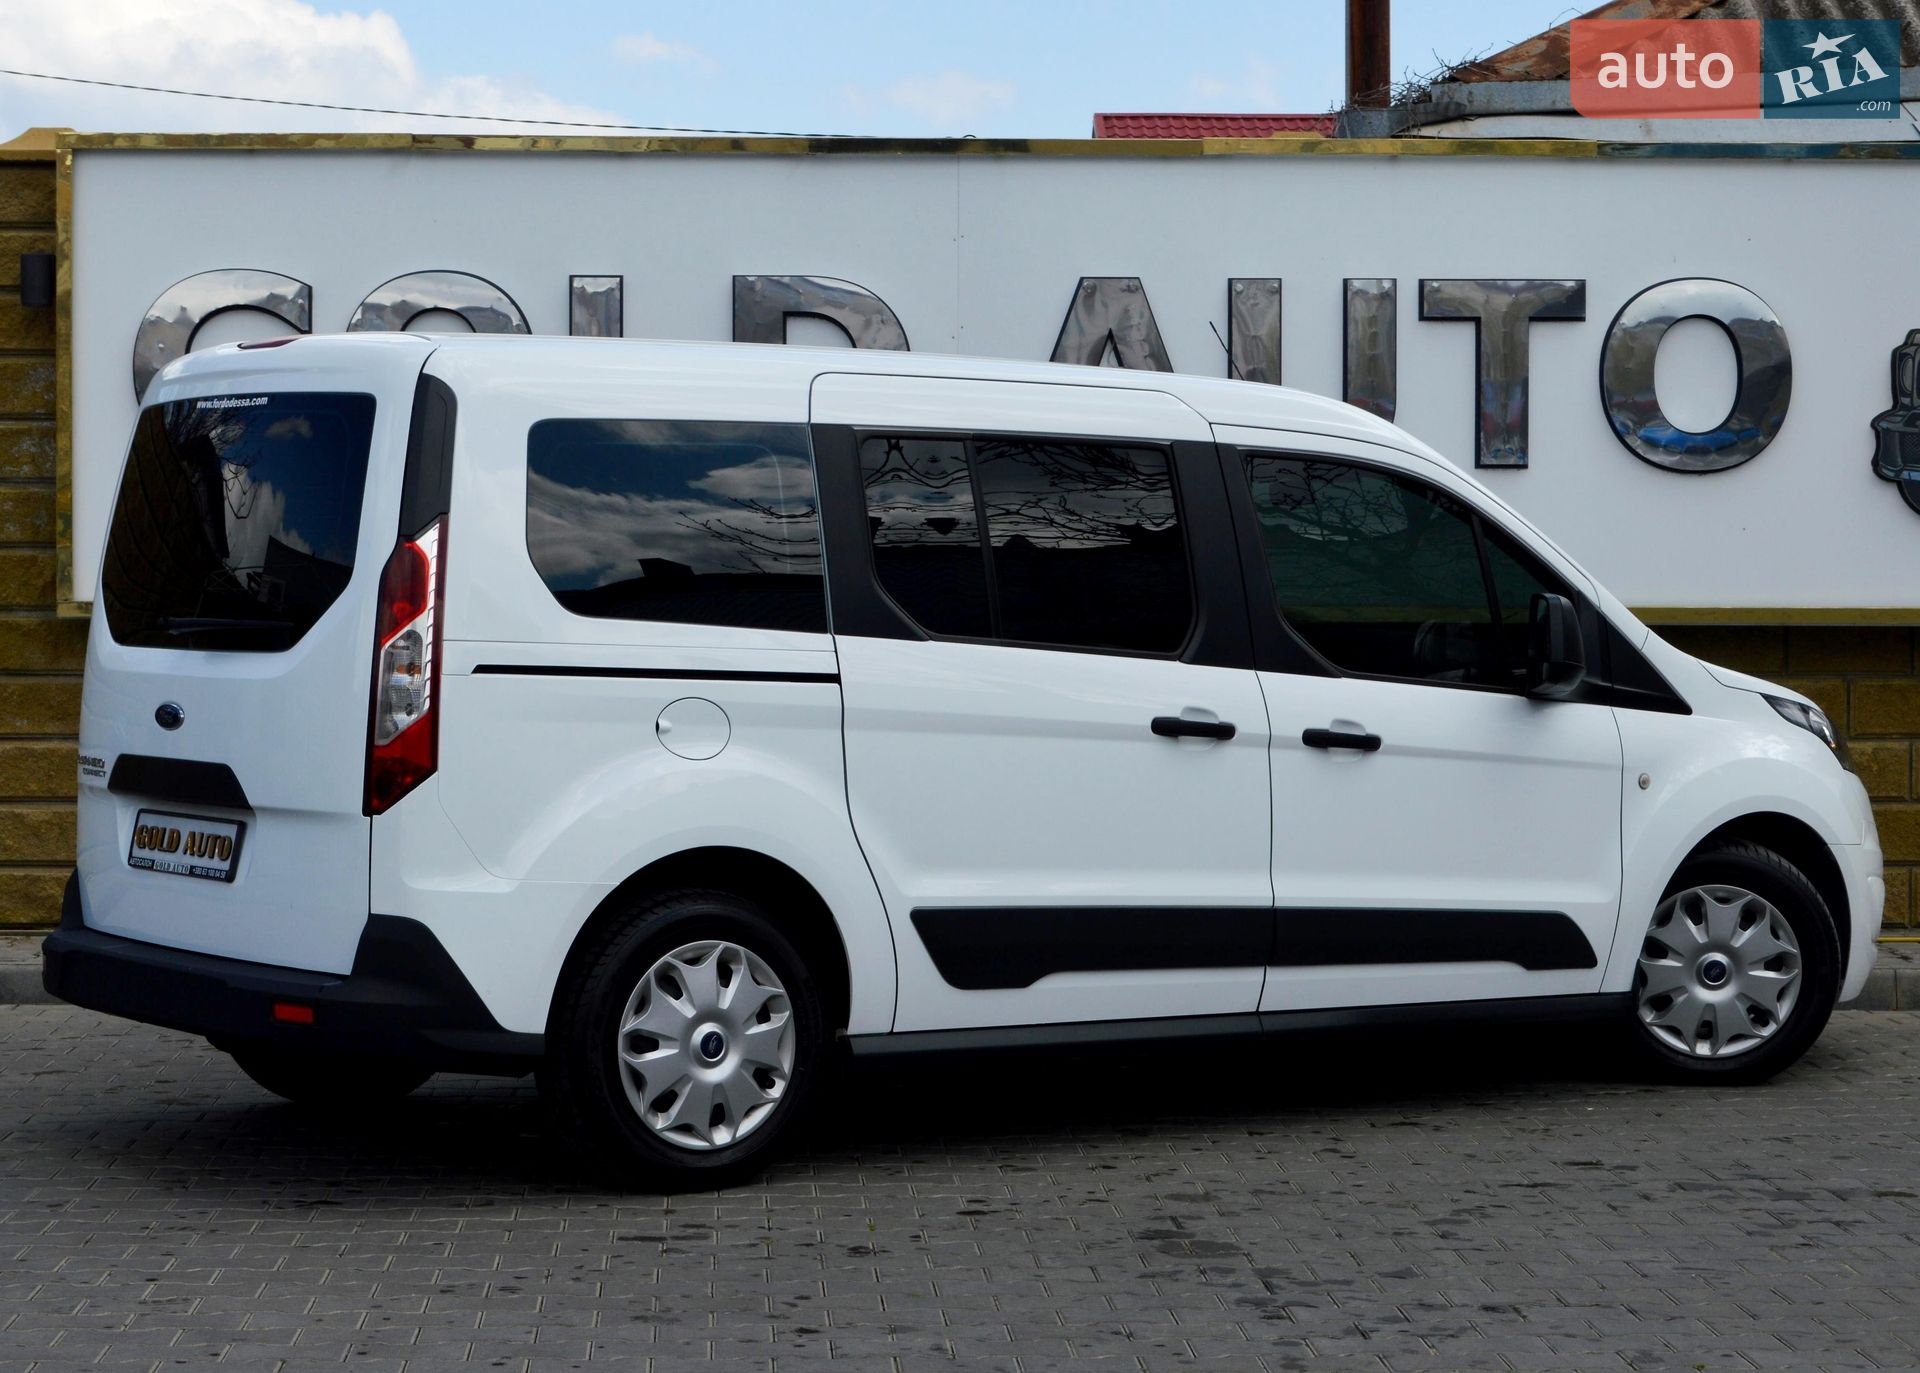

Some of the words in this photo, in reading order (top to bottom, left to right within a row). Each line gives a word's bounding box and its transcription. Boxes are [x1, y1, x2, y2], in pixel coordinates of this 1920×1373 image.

[196, 397, 268, 409] www.fordodessa.com
[134, 825, 181, 853] GOLD
[183, 831, 233, 860] AUTO
